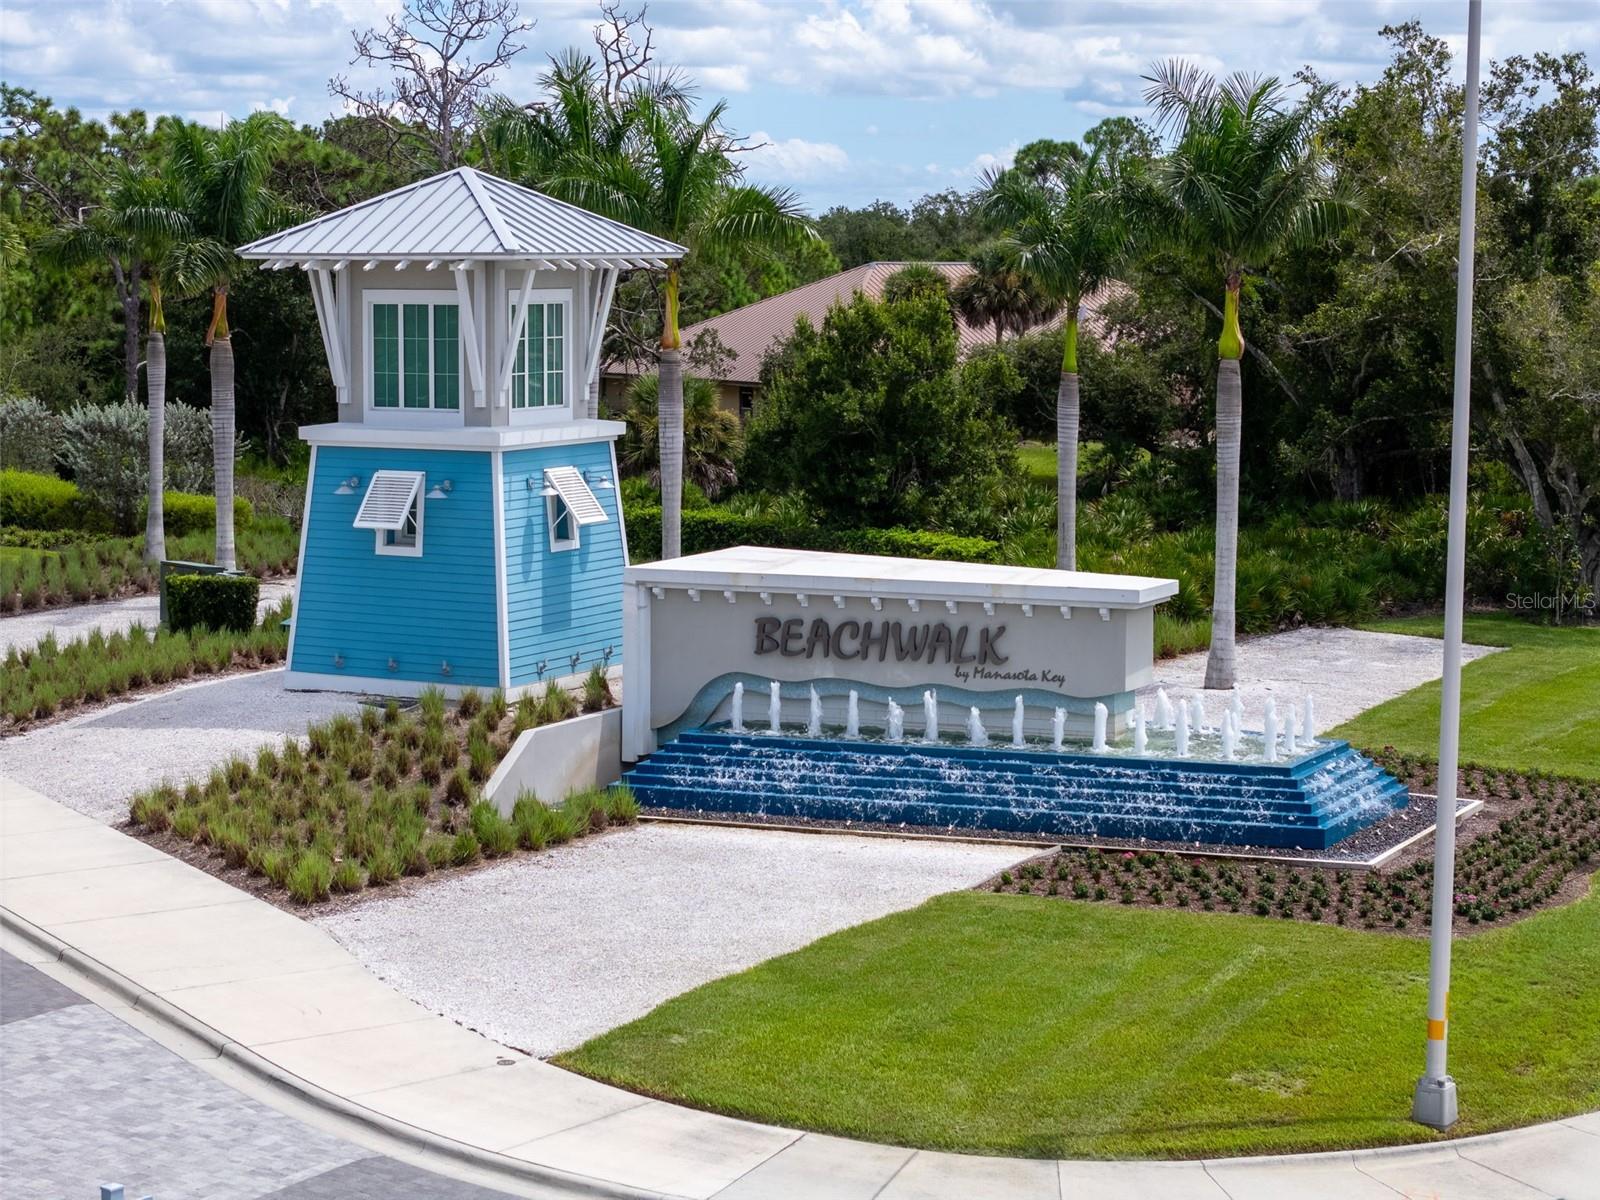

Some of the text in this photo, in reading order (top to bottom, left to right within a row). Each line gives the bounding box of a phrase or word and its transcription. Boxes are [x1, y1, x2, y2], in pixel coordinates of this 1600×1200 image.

[754, 617, 1009, 666] BEACHWALK
[954, 665, 1066, 688] by Manasota Key
